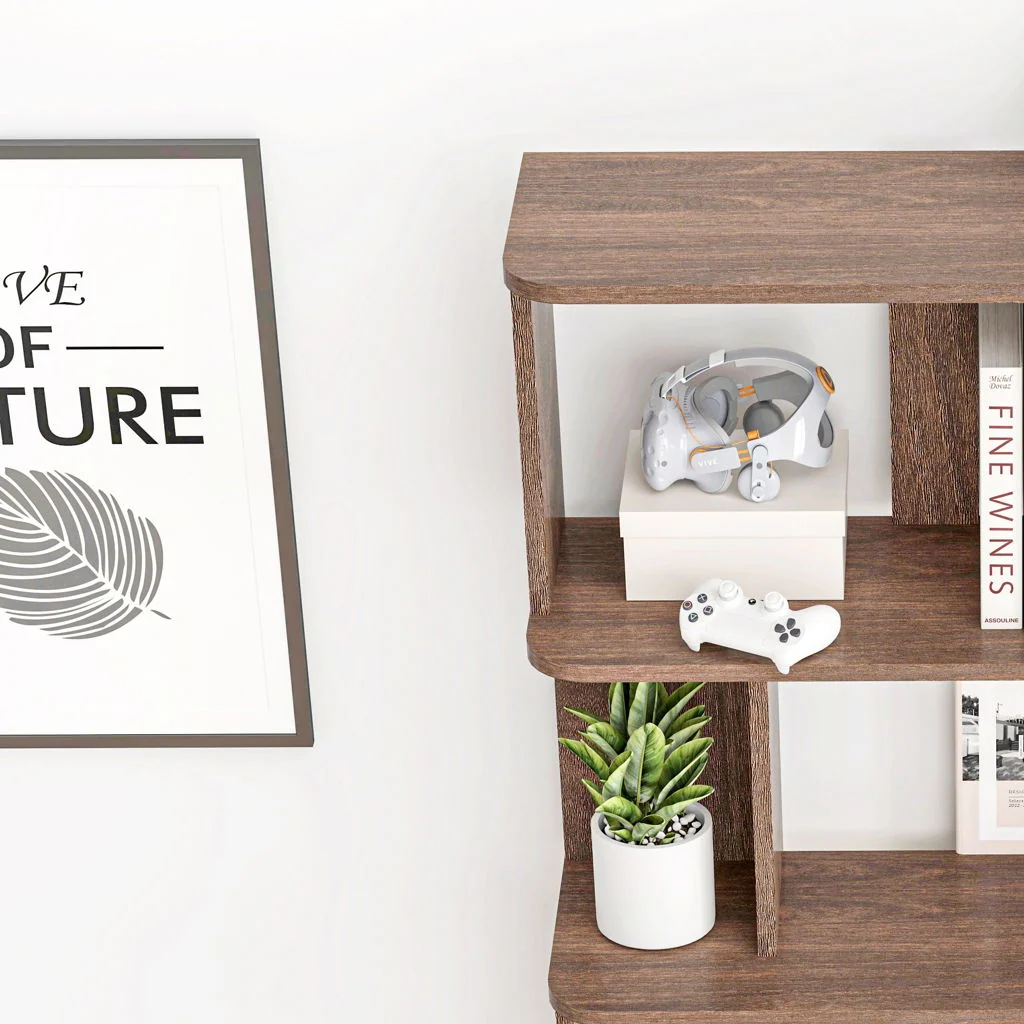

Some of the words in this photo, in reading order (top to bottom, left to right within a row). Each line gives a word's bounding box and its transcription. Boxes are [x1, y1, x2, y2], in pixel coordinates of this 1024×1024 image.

[0, 386, 204, 446] TURE
[988, 406, 1014, 476] FINE
[988, 491, 1014, 594] WINES
